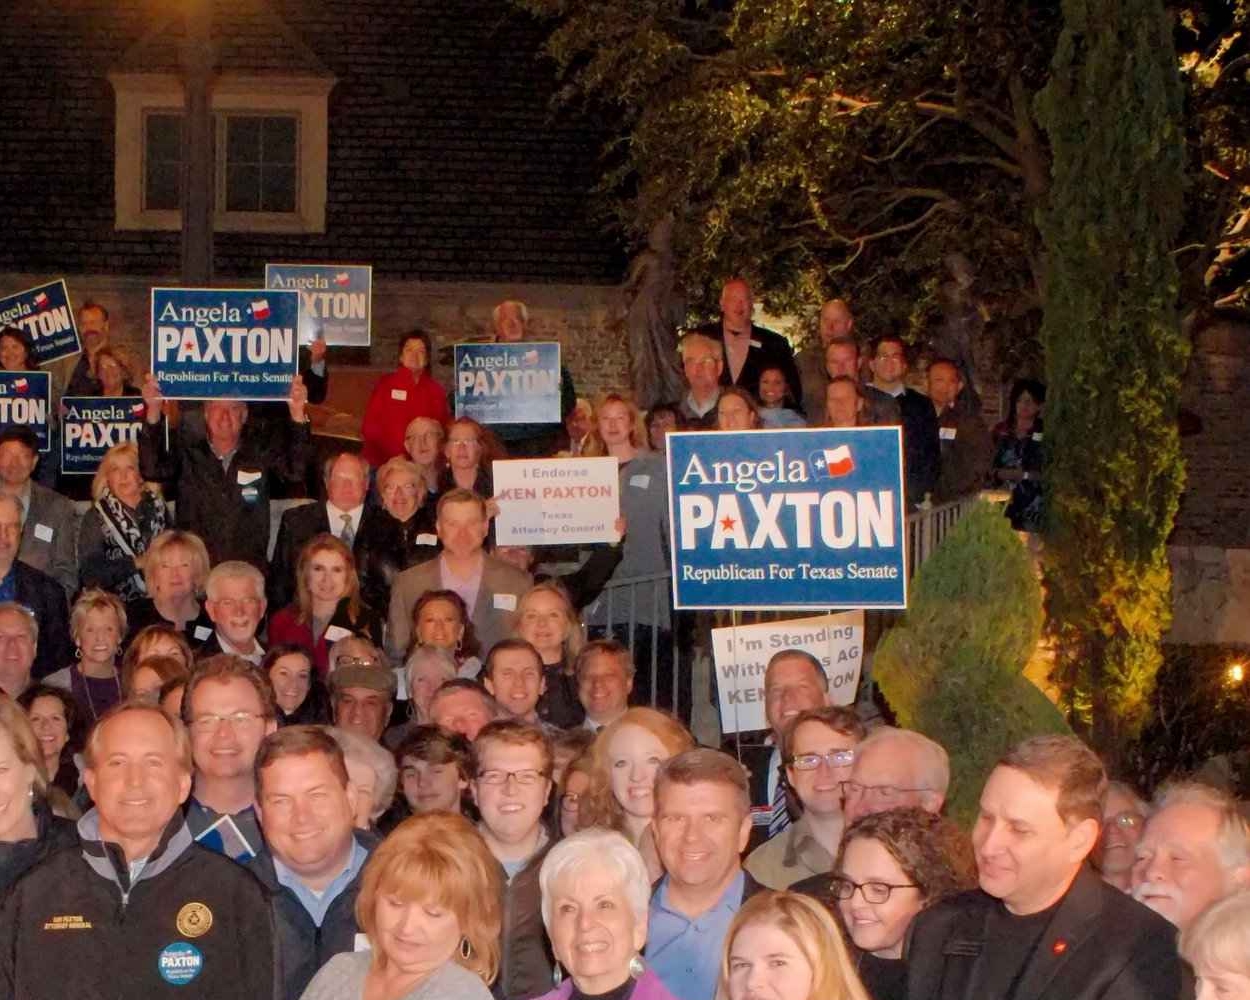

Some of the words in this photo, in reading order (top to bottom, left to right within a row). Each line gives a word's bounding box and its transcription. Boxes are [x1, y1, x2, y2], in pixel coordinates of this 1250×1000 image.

[271, 273, 329, 290] Angela
[158, 301, 242, 327] Angela
[301, 292, 366, 319] XTON
[158, 327, 292, 364] PAXTON
[459, 352, 518, 371] Angela
[158, 371, 210, 384] Republican
[213, 372, 230, 382] For
[233, 372, 260, 383] Texas
[262, 372, 293, 383] Senate
[458, 369, 556, 396] PAXTON
[66, 405, 125, 424] Angela
[523, 469, 527, 479] I
[532, 468, 588, 479] Endorse
[679, 450, 808, 493] Angela
[500, 488, 536, 500] KEN
[542, 485, 612, 499] PAXTON
[542, 512, 573, 520] Texas
[679, 490, 895, 550] PAXTON
[512, 525, 559, 536] Attorney
[562, 524, 605, 534] General
[682, 565, 765, 584] Republican
[768, 564, 796, 580] For
[798, 563, 844, 580] Texas
[847, 562, 898, 580] Senate
[837, 646, 860, 664] AG
[161, 956, 200, 968] PAXTON
